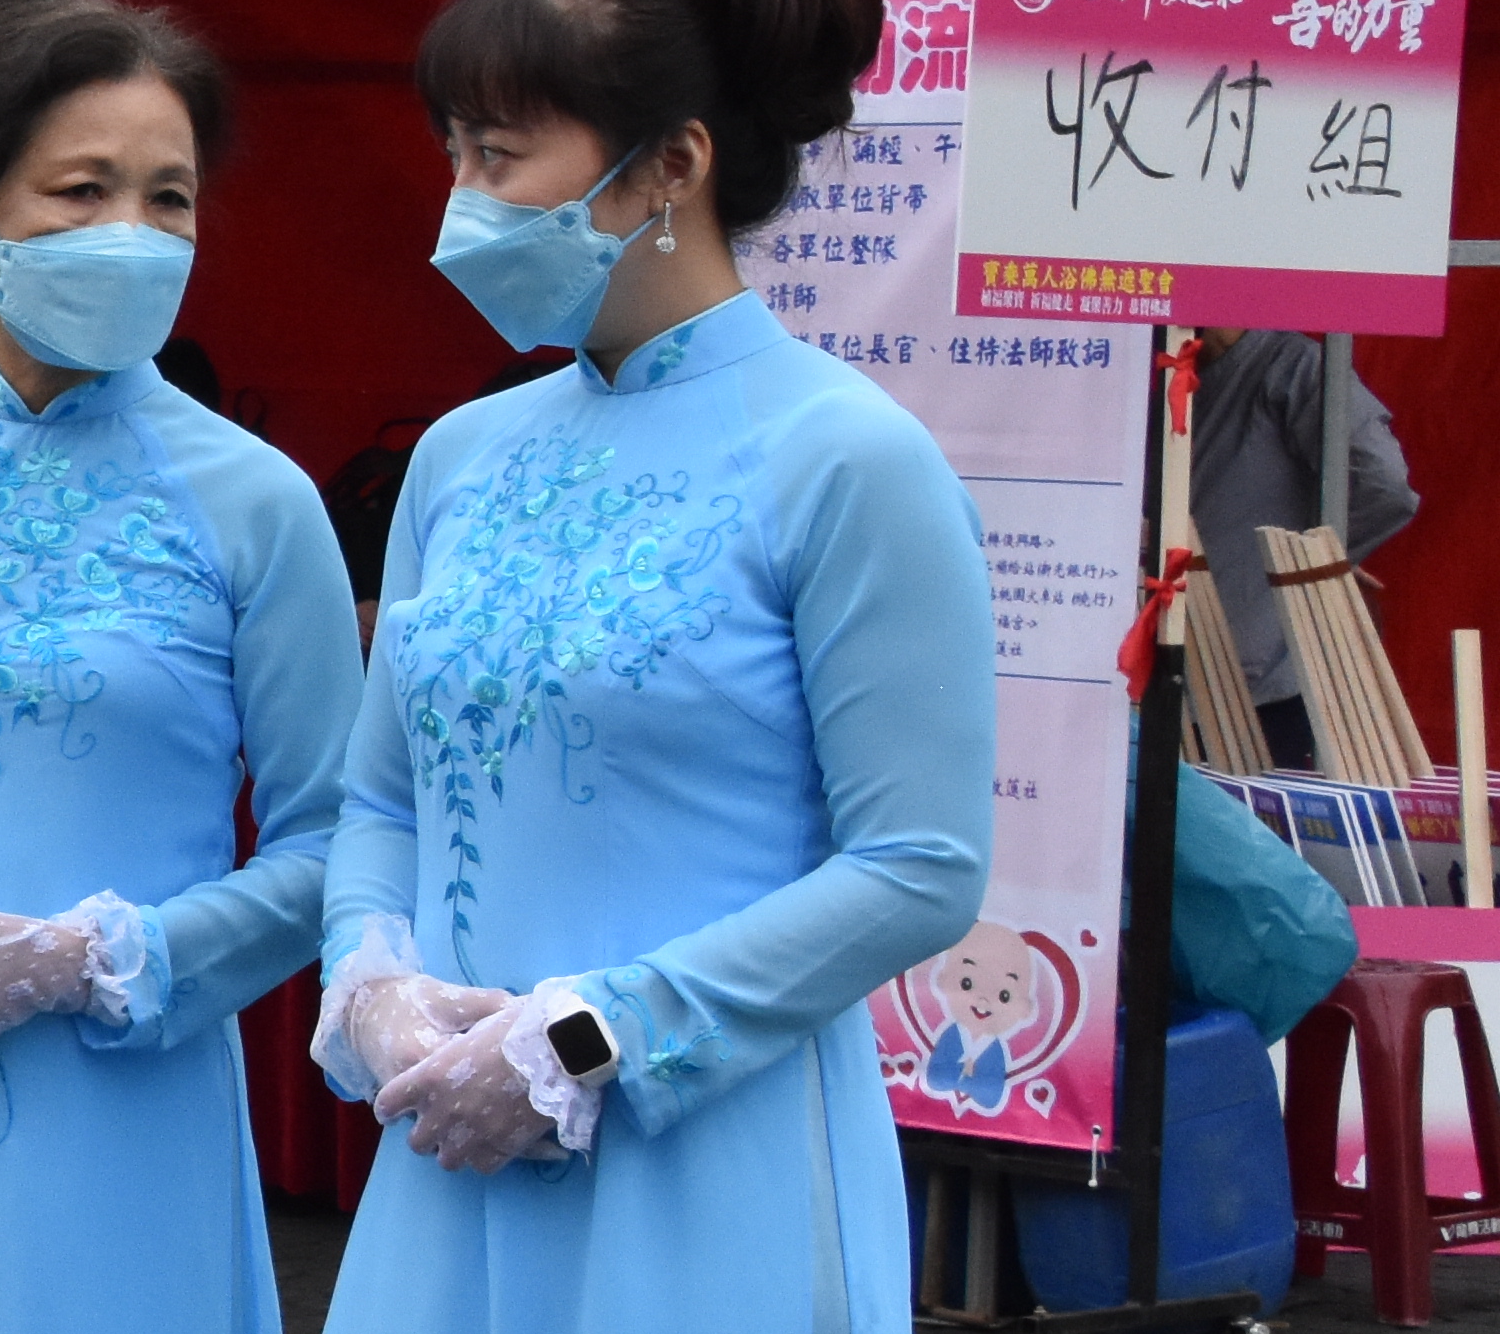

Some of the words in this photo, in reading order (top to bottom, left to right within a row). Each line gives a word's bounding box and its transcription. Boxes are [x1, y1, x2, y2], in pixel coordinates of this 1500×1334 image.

[1046, 49, 1403, 211] 收付組
[852, 134, 963, 165] 誦經、午
[789, 184, 928, 215] 取單位背帶
[772, 233, 899, 265] 各單位整隊
[792, 331, 1111, 369] 單位長官、住持法師致詞
